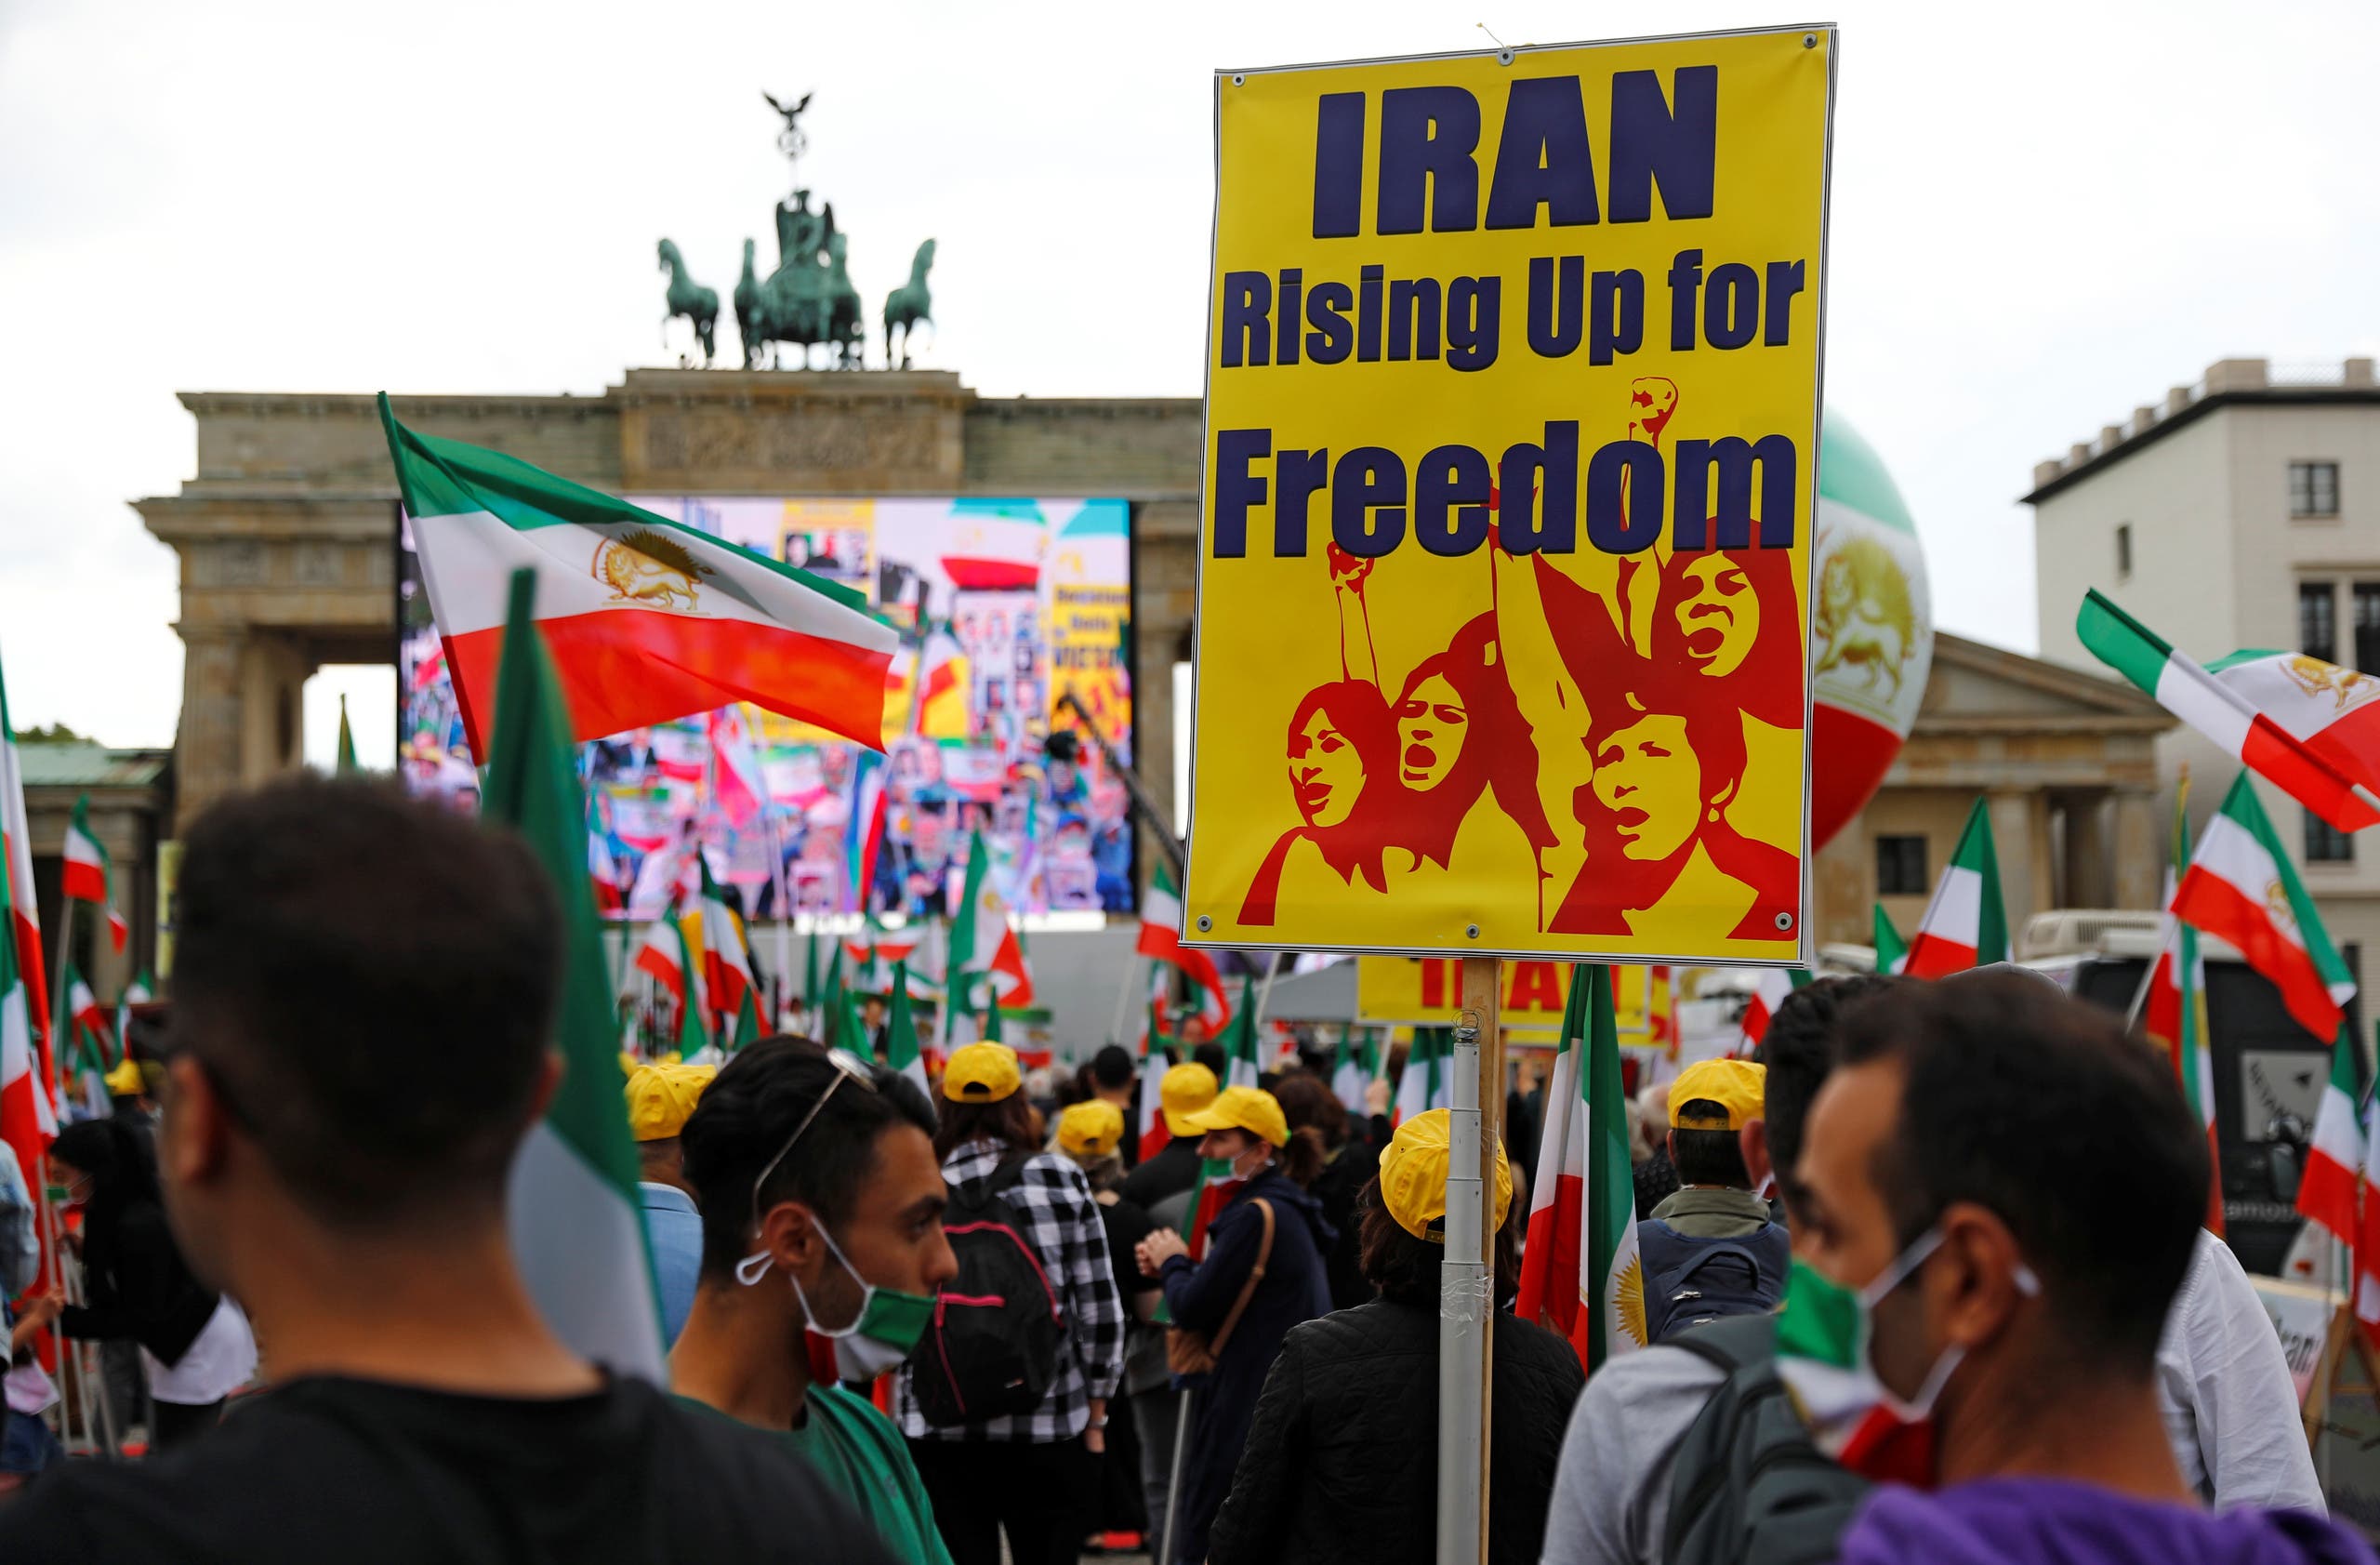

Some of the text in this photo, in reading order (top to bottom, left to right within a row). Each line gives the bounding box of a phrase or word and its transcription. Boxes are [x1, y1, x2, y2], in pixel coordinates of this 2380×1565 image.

[1313, 65, 1718, 239] IRAN
[1221, 249, 1805, 372] Rising Up for
[1213, 419, 1796, 558] Freedom
